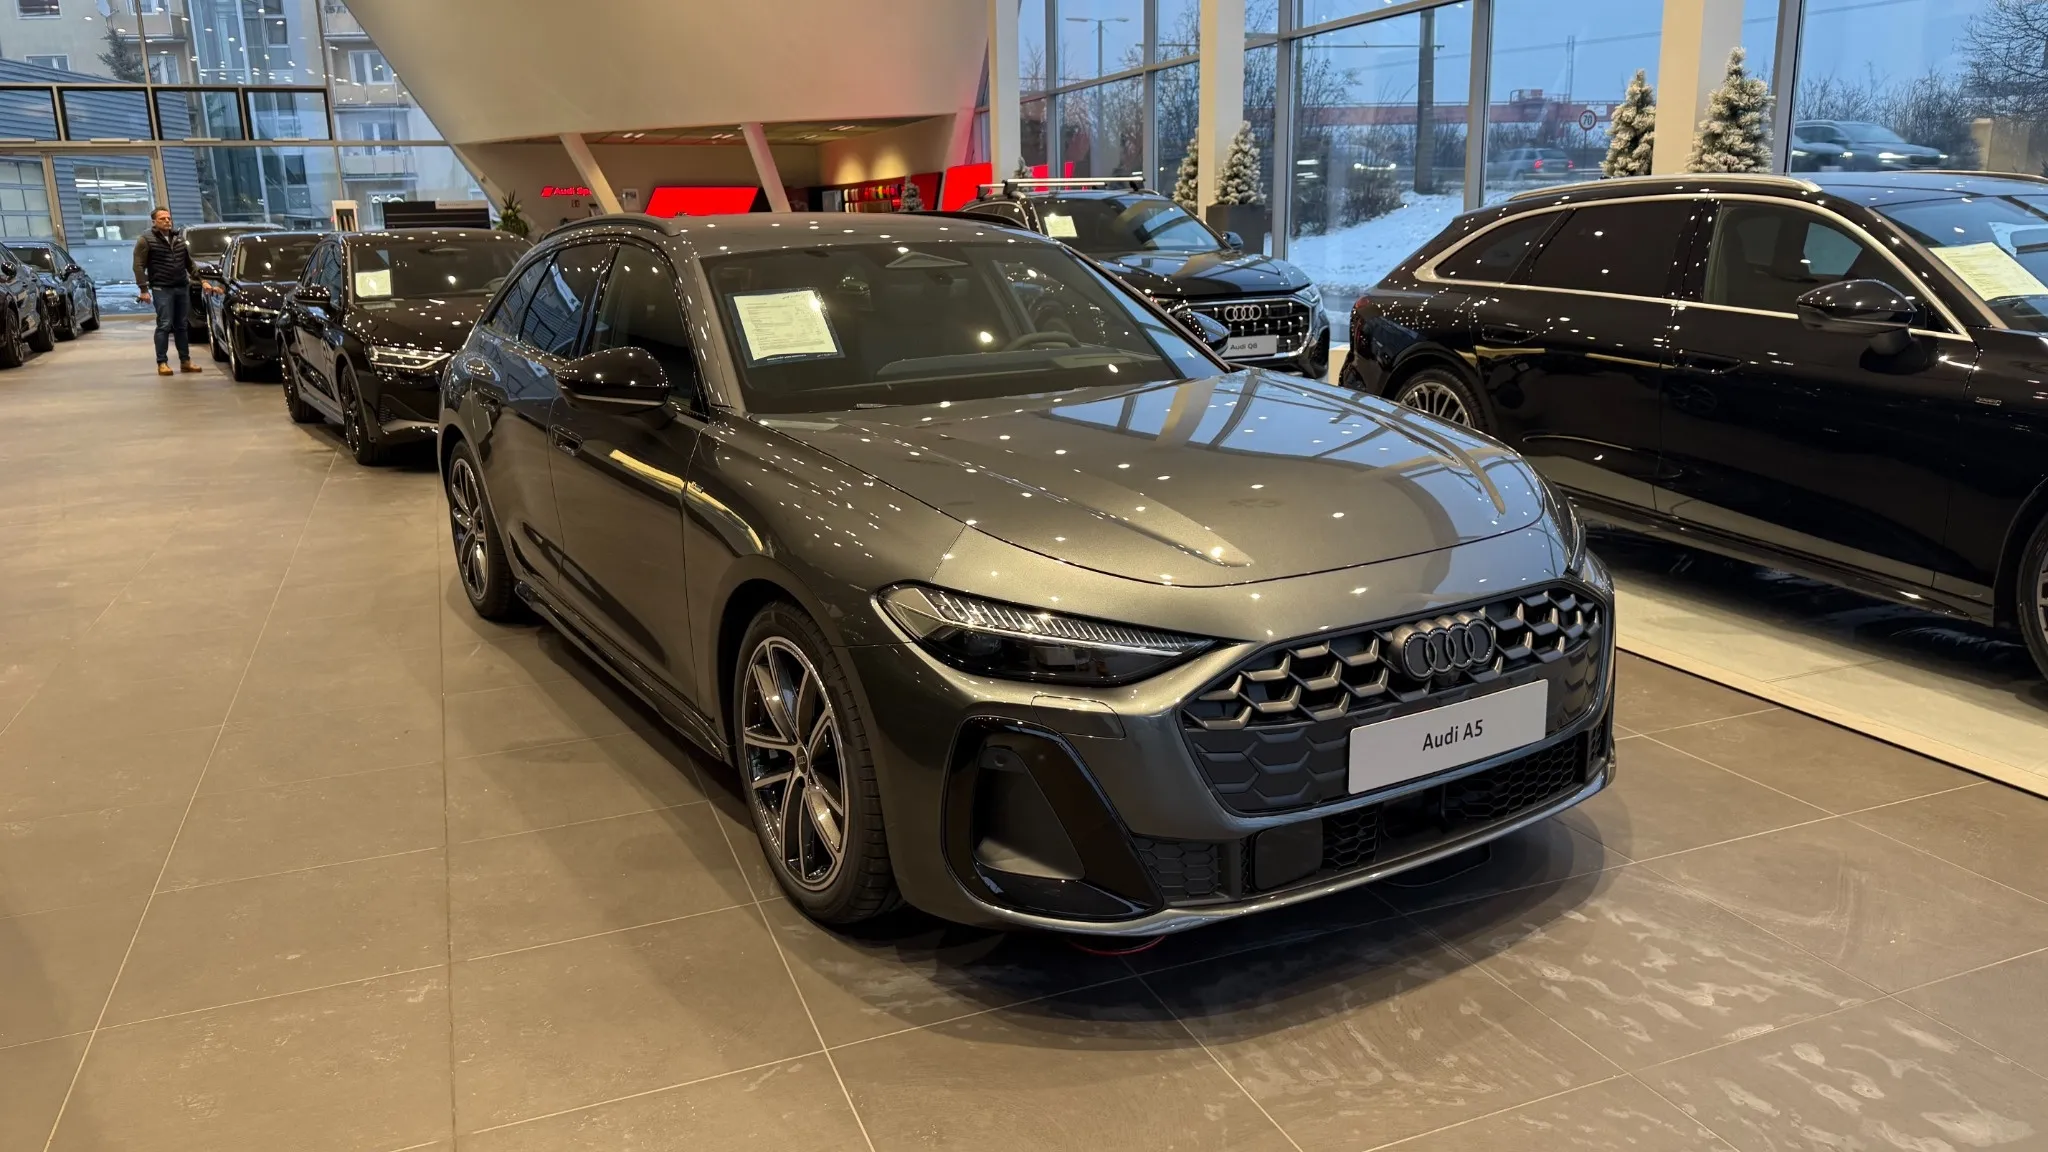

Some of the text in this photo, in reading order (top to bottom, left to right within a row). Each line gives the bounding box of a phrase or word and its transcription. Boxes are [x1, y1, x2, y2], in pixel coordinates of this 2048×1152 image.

[1583, 115, 1592, 126] 70
[554, 187, 575, 196] Audi
[1247, 342, 1258, 350] Q8
[1422, 719, 1483, 751] Audi A5
